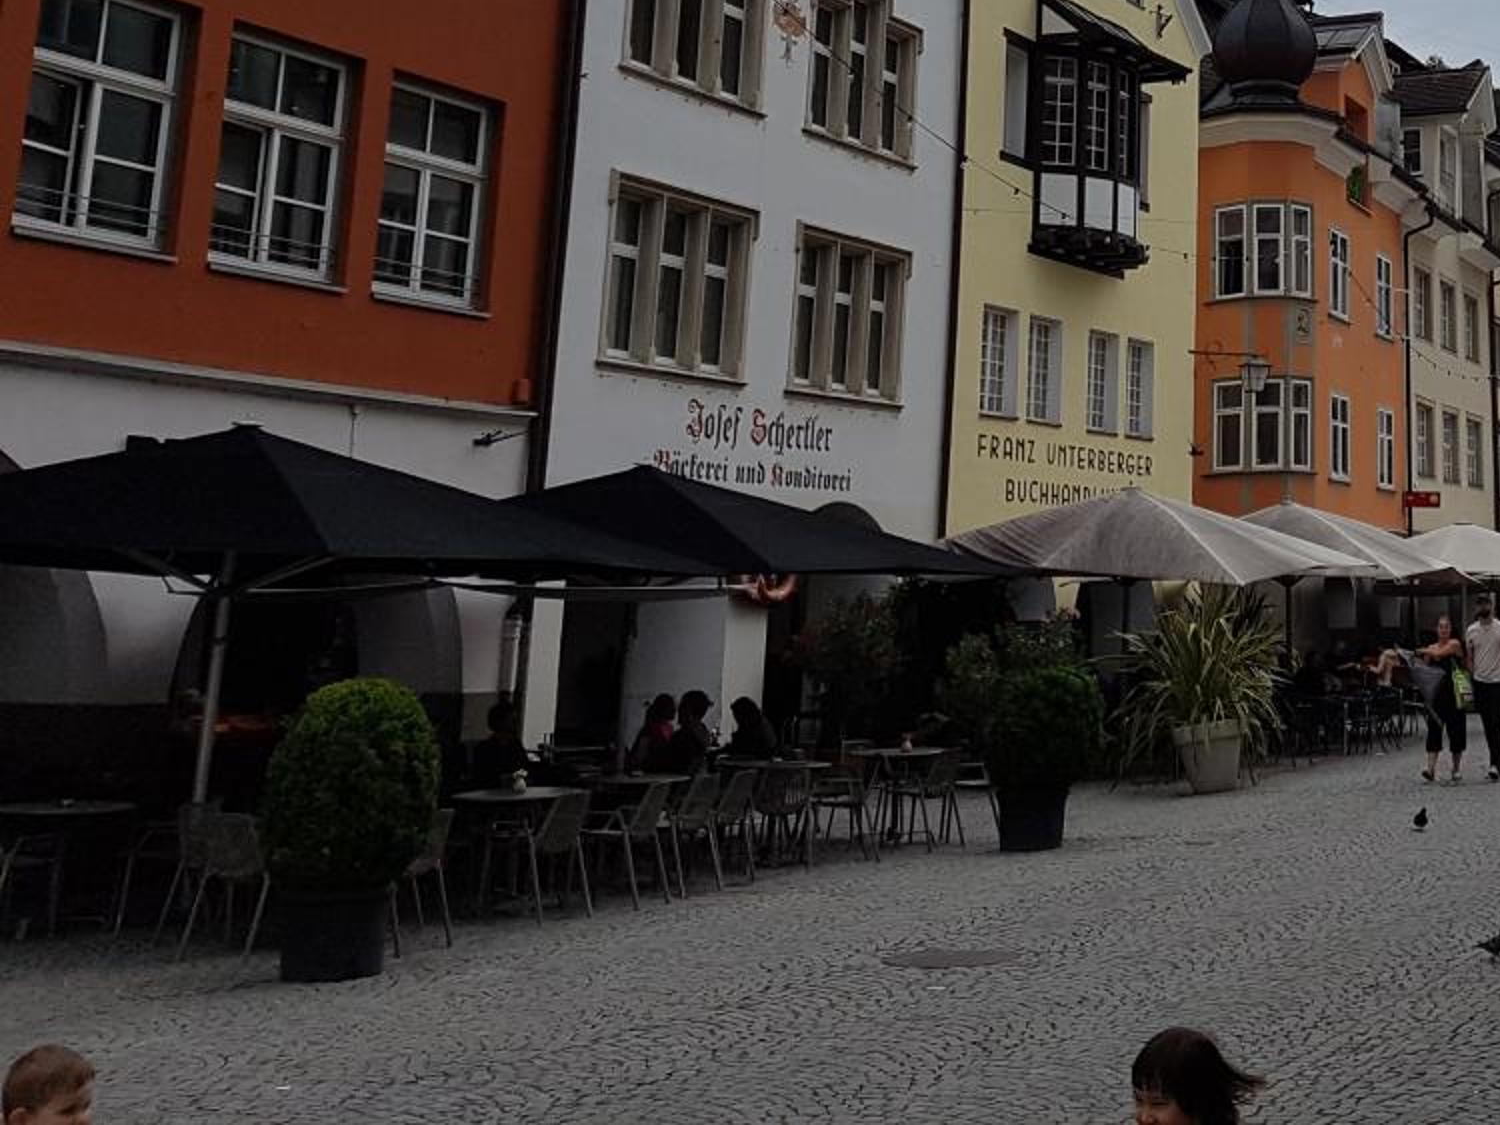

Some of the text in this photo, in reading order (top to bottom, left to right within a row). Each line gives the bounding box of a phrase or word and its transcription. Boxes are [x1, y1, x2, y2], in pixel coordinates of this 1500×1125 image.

[686, 398, 743, 450] Josef
[653, 449, 852, 492] Bäckerei und Konditorei
[977, 434, 1153, 476] FRANZ UNTERBERGER
